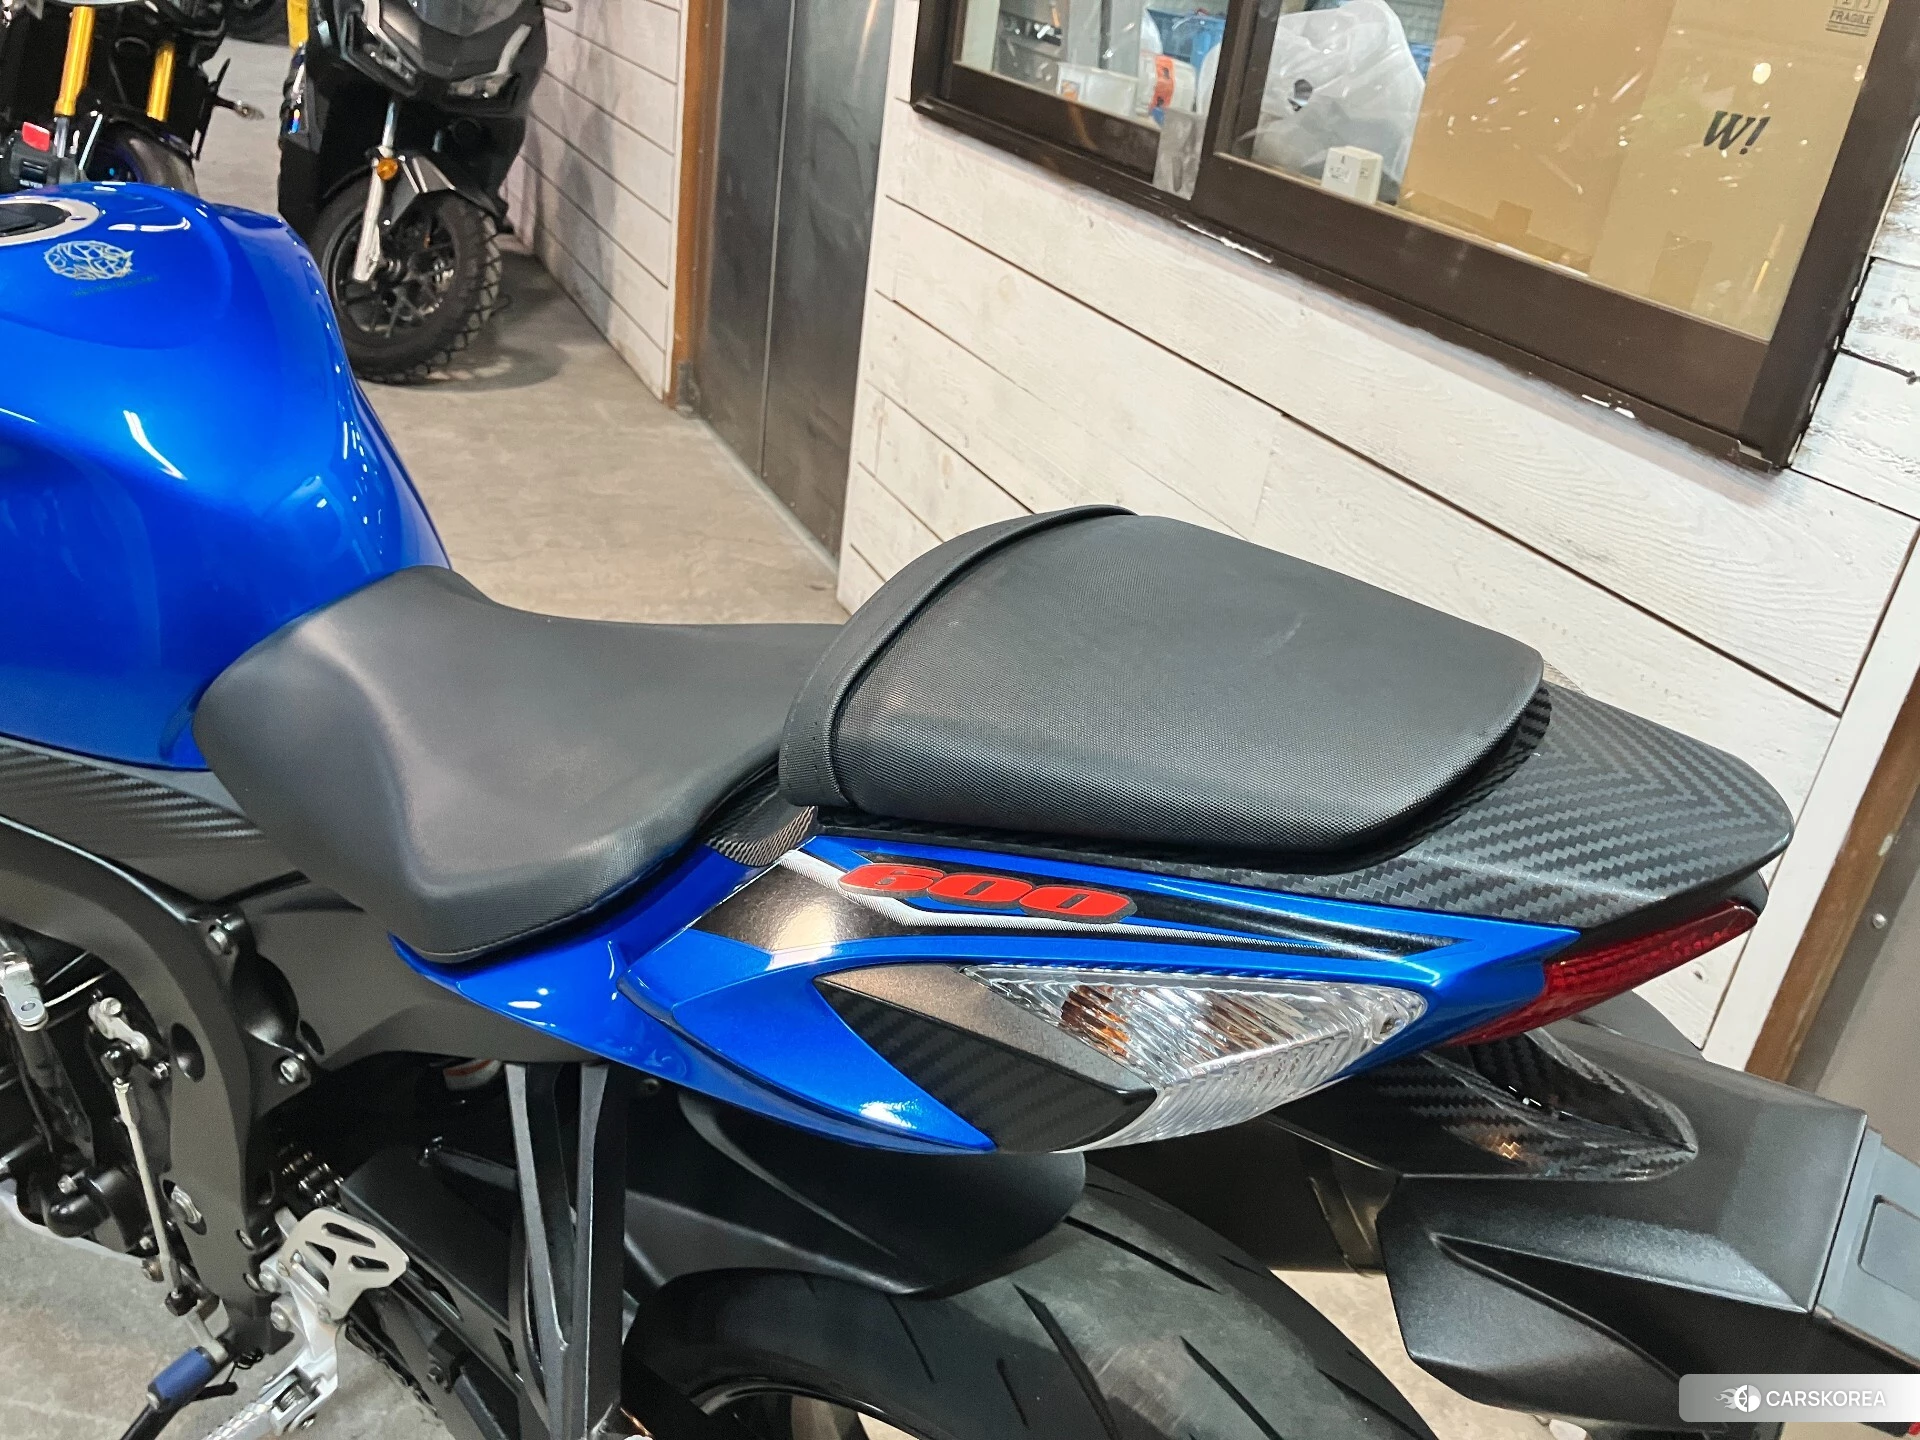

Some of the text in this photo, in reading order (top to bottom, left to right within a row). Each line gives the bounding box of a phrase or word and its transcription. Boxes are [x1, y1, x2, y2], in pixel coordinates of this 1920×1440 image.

[1830, 9, 1874, 25] FRAGILE
[1703, 110, 1771, 155] W!
[838, 863, 1136, 922] 600
